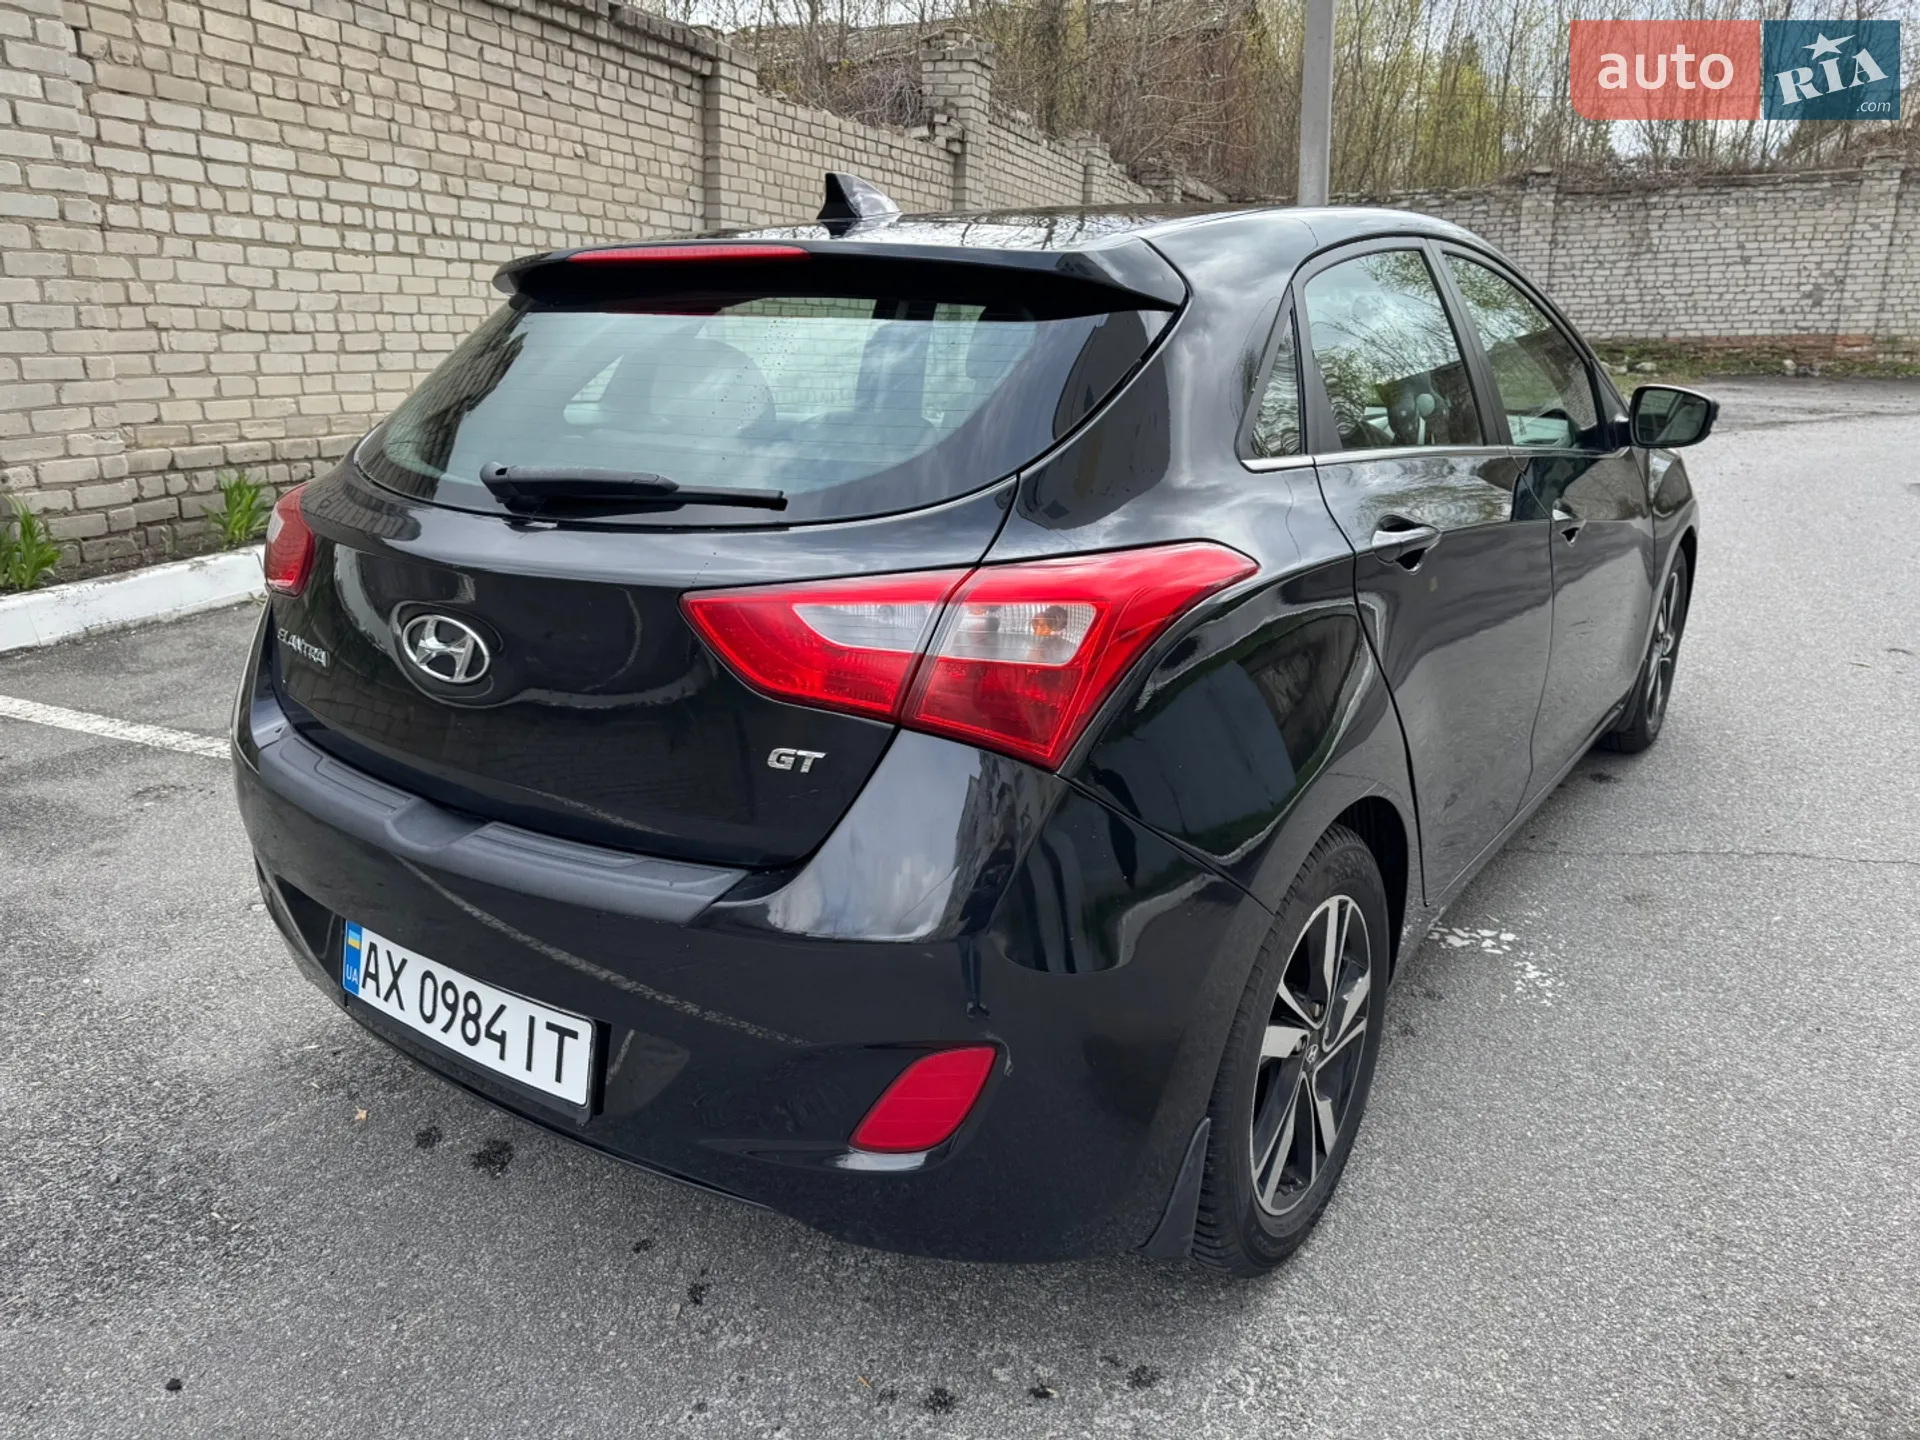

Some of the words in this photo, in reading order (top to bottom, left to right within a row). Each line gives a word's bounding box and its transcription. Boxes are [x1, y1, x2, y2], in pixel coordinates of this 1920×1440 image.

[767, 747, 827, 773] GT
[346, 963, 359, 985] UA
[361, 941, 408, 1012] AX
[419, 969, 507, 1062] 0984
[525, 1014, 579, 1084] IT
